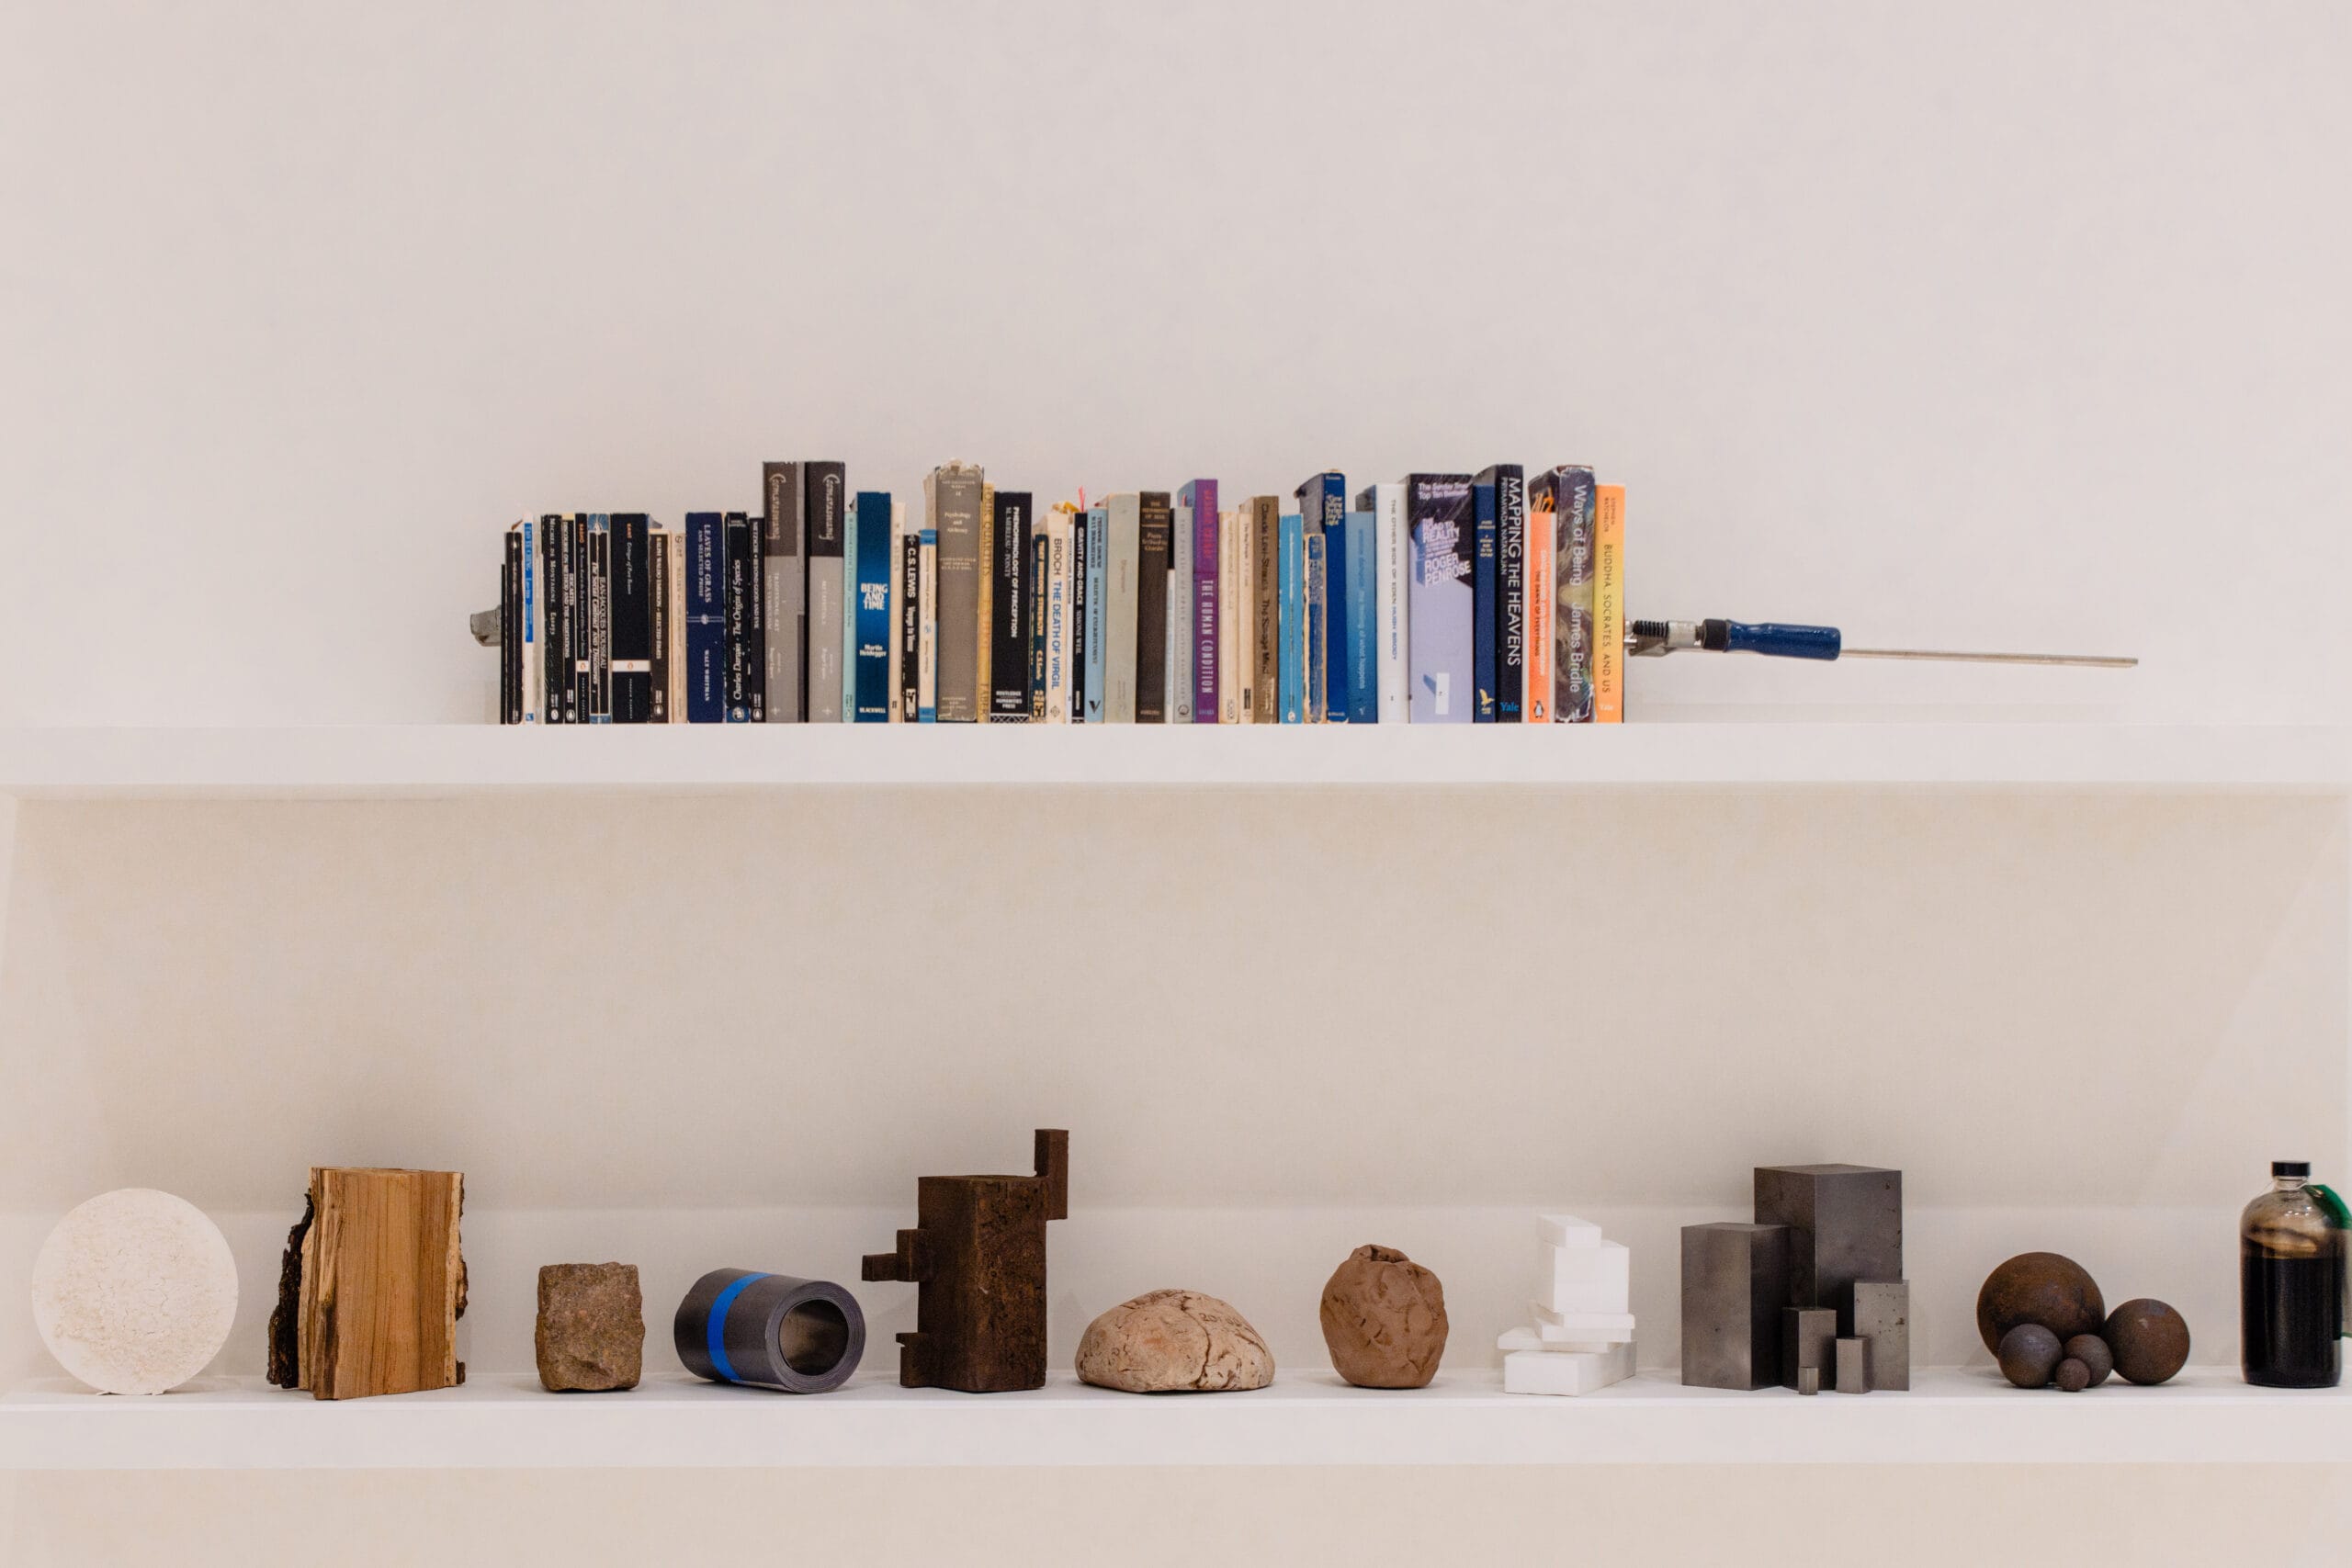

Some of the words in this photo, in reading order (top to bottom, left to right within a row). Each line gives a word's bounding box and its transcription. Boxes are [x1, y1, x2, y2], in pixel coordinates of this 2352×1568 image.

[1418, 482, 1431, 491] The
[1418, 491, 1431, 501] Top
[983, 487, 993, 516] FOUR
[1572, 485, 1586, 525] Ways
[1261, 503, 1270, 535] Claude
[1508, 477, 1521, 558] MAPPING
[1422, 526, 1460, 543] REALITY
[1573, 527, 1585, 543] of
[704, 559, 711, 571] OF
[1054, 538, 1062, 576] BROCH
[1424, 553, 1459, 573] ROGER
[1570, 546, 1587, 586] Being
[732, 559, 742, 586] Species
[907, 568, 917, 599] LEWIS
[1012, 578, 1020, 589] OF
[1392, 568, 1396, 580] OF
[1424, 560, 1472, 588] PENROSE
[1508, 562, 1521, 588] THE
[860, 583, 888, 593] BEING
[865, 592, 885, 602] AND
[1052, 581, 1062, 602] THE
[1202, 580, 1214, 596] THE
[600, 577, 608, 629] JEAN-JACQUES
[732, 594, 742, 619] Origin
[864, 601, 885, 610] TIME
[1534, 605, 1541, 615] OF
[733, 620, 741, 636] The
[905, 606, 916, 627] Voyage
[1052, 604, 1062, 638] DEATH
[1202, 602, 1214, 635] HUMAN
[1508, 591, 1521, 667] HEAVENS
[1571, 603, 1583, 649] James
[907, 635, 915, 652] Venus
[1261, 617, 1270, 651] Savage
[600, 630, 608, 669] ROUSSEAU
[733, 643, 741, 671] Darwin
[1052, 640, 1062, 655] OF
[1358, 639, 1366, 658] what
[1052, 656, 1062, 690] VIRGIL
[1202, 639, 1214, 694] CONDITION
[1358, 659, 1366, 690] happens
[1570, 652, 1583, 694] Bridle
[1603, 653, 1613, 677] AND
[733, 672, 741, 701] Charles
[980, 682, 990, 716] FABER
[1603, 680, 1613, 694] US
[1499, 701, 1520, 712] Yale
